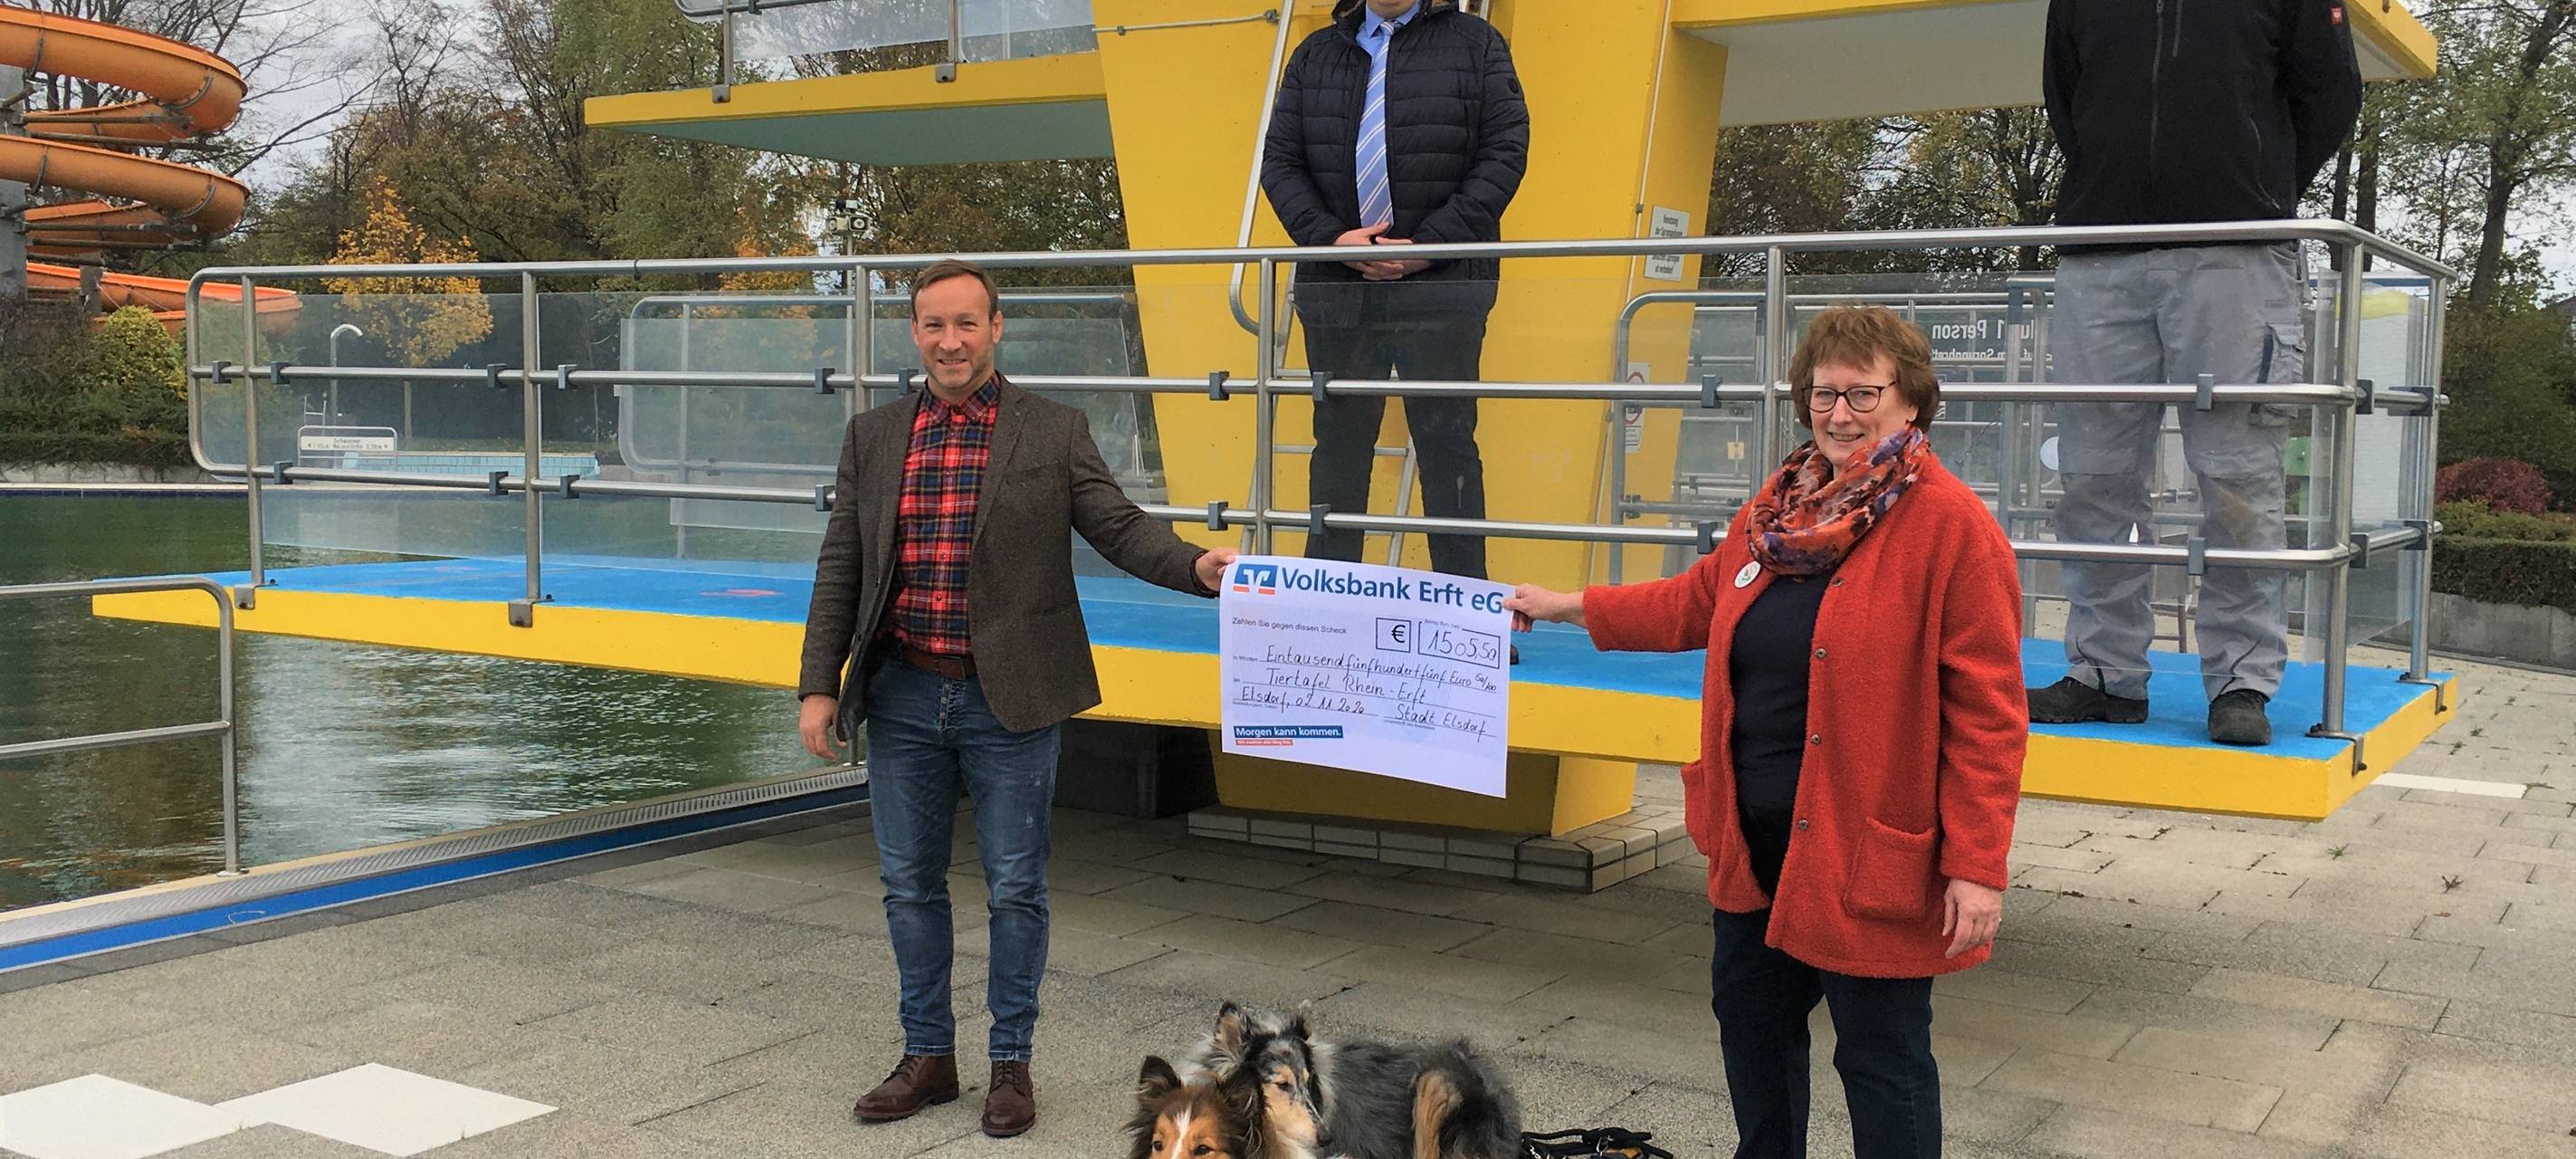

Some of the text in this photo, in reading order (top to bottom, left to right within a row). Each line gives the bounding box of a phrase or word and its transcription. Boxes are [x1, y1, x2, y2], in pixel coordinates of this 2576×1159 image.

[1282, 567, 1503, 614] Volksbank Erft eG
[1232, 617, 1348, 635] Zahlen Sie gegen diesen Scheck
[1391, 624, 1407, 644] €
[1266, 667, 1331, 696] Tiertafel
[1342, 674, 1385, 696] Rhein
[1449, 670, 1472, 687] Euro
[1235, 726, 1342, 737] Morgen kann kommen.
[1395, 703, 1436, 723] Stadt
[1443, 712, 1485, 742] Elsdorf
